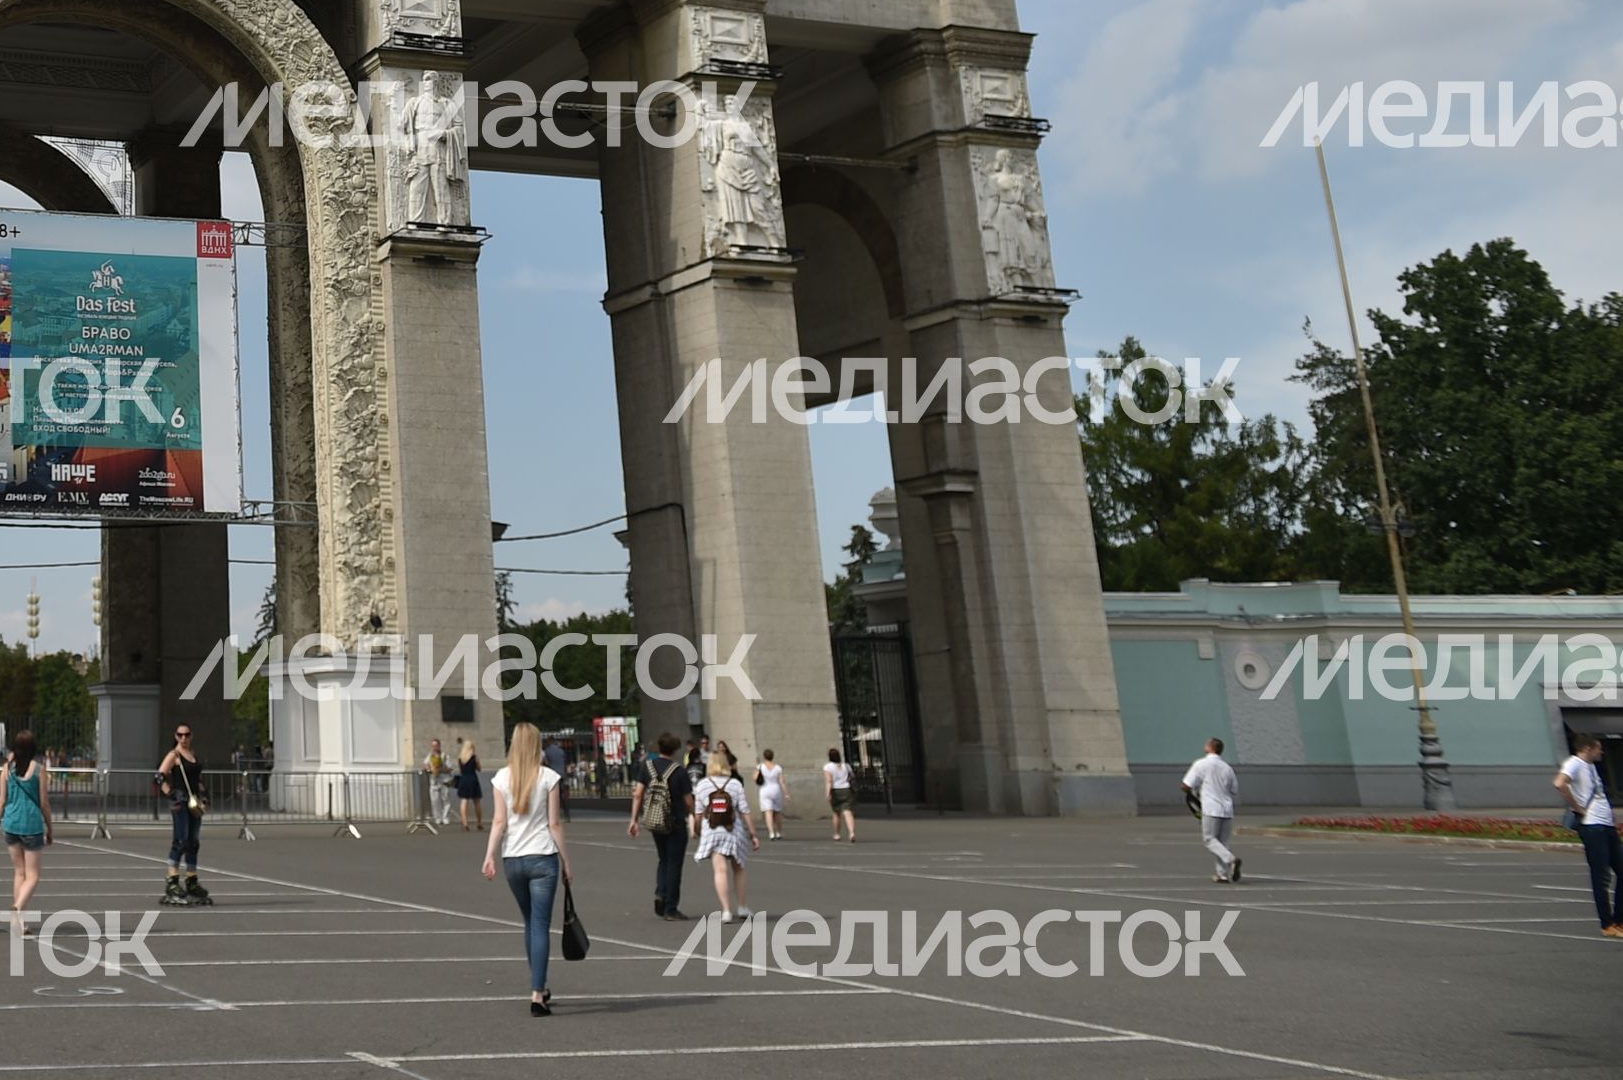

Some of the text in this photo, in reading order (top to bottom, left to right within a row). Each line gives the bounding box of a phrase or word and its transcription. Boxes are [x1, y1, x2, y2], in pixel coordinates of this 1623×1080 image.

[201, 245, 227, 255] ВДНХ
[76, 295, 103, 311] Das
[82, 326, 131, 340] БРАВО
[69, 342, 144, 356] UMA2RMAN
[170, 407, 185, 429] 6
[33, 424, 111, 434] ВХОД СВОБОДНЫЙ!
[51, 463, 96, 482] НАШЕ
